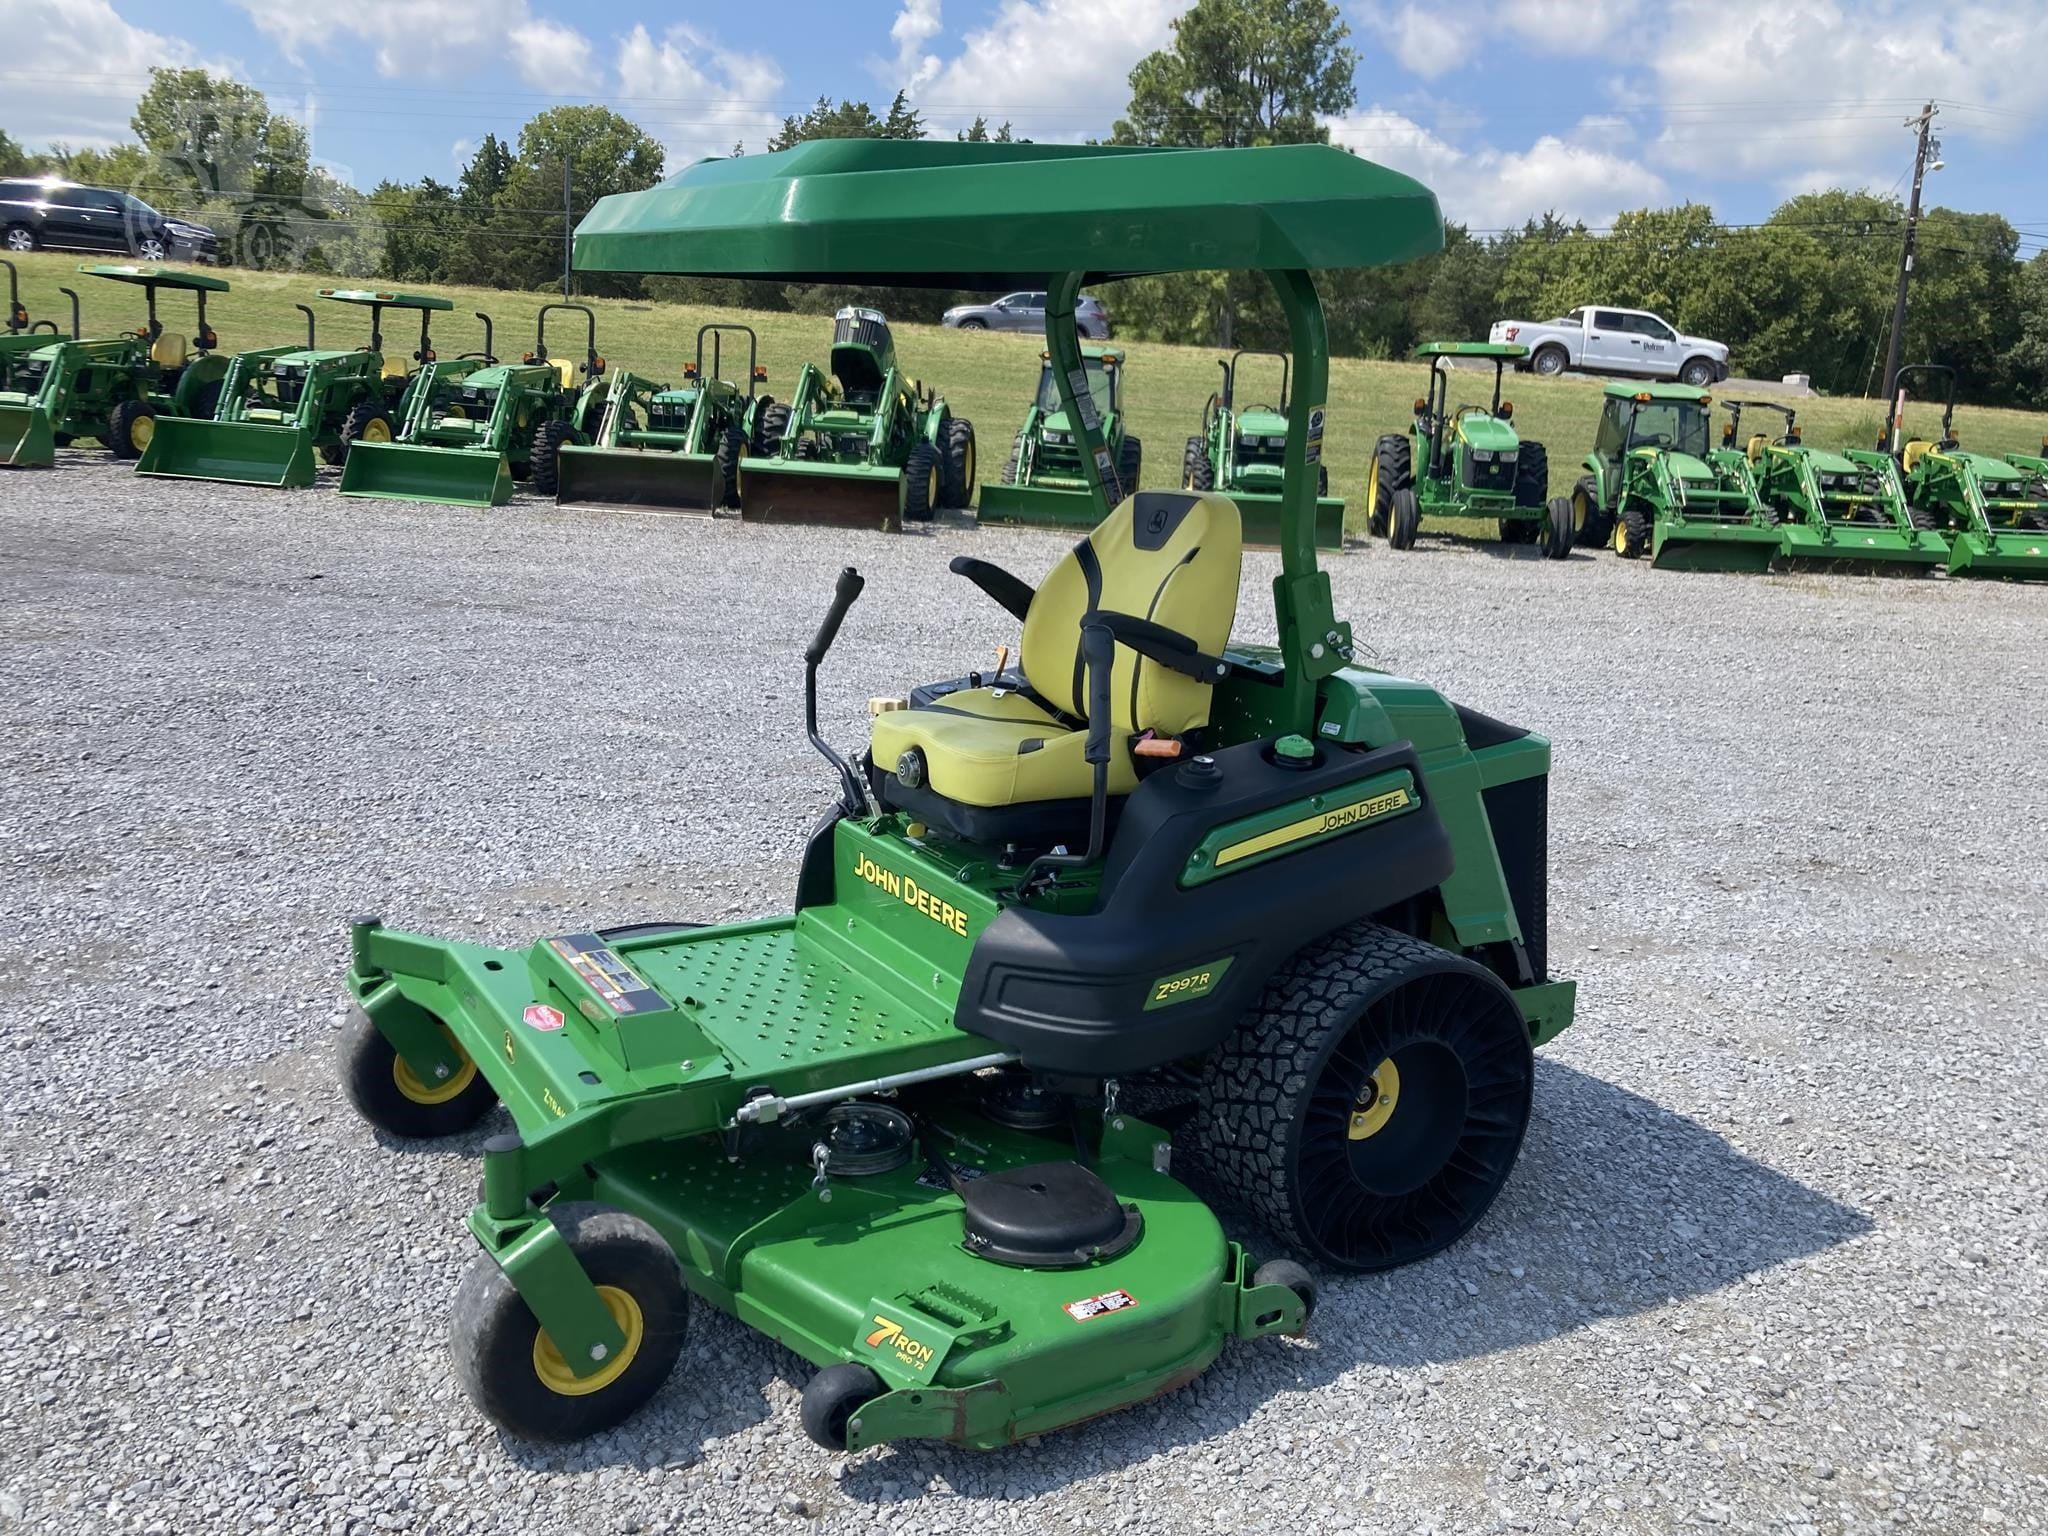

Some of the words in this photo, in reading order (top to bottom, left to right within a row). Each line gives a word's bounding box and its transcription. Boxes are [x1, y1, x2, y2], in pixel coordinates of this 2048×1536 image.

[1319, 808, 1357, 832] JOHN
[1359, 795, 1401, 819] DEERE
[854, 851, 901, 899] JOHN
[903, 875, 968, 938] DEERE
[1155, 972, 1210, 1001] Z997R
[895, 1351, 913, 1364] PRO
[913, 1360, 925, 1371] 72
